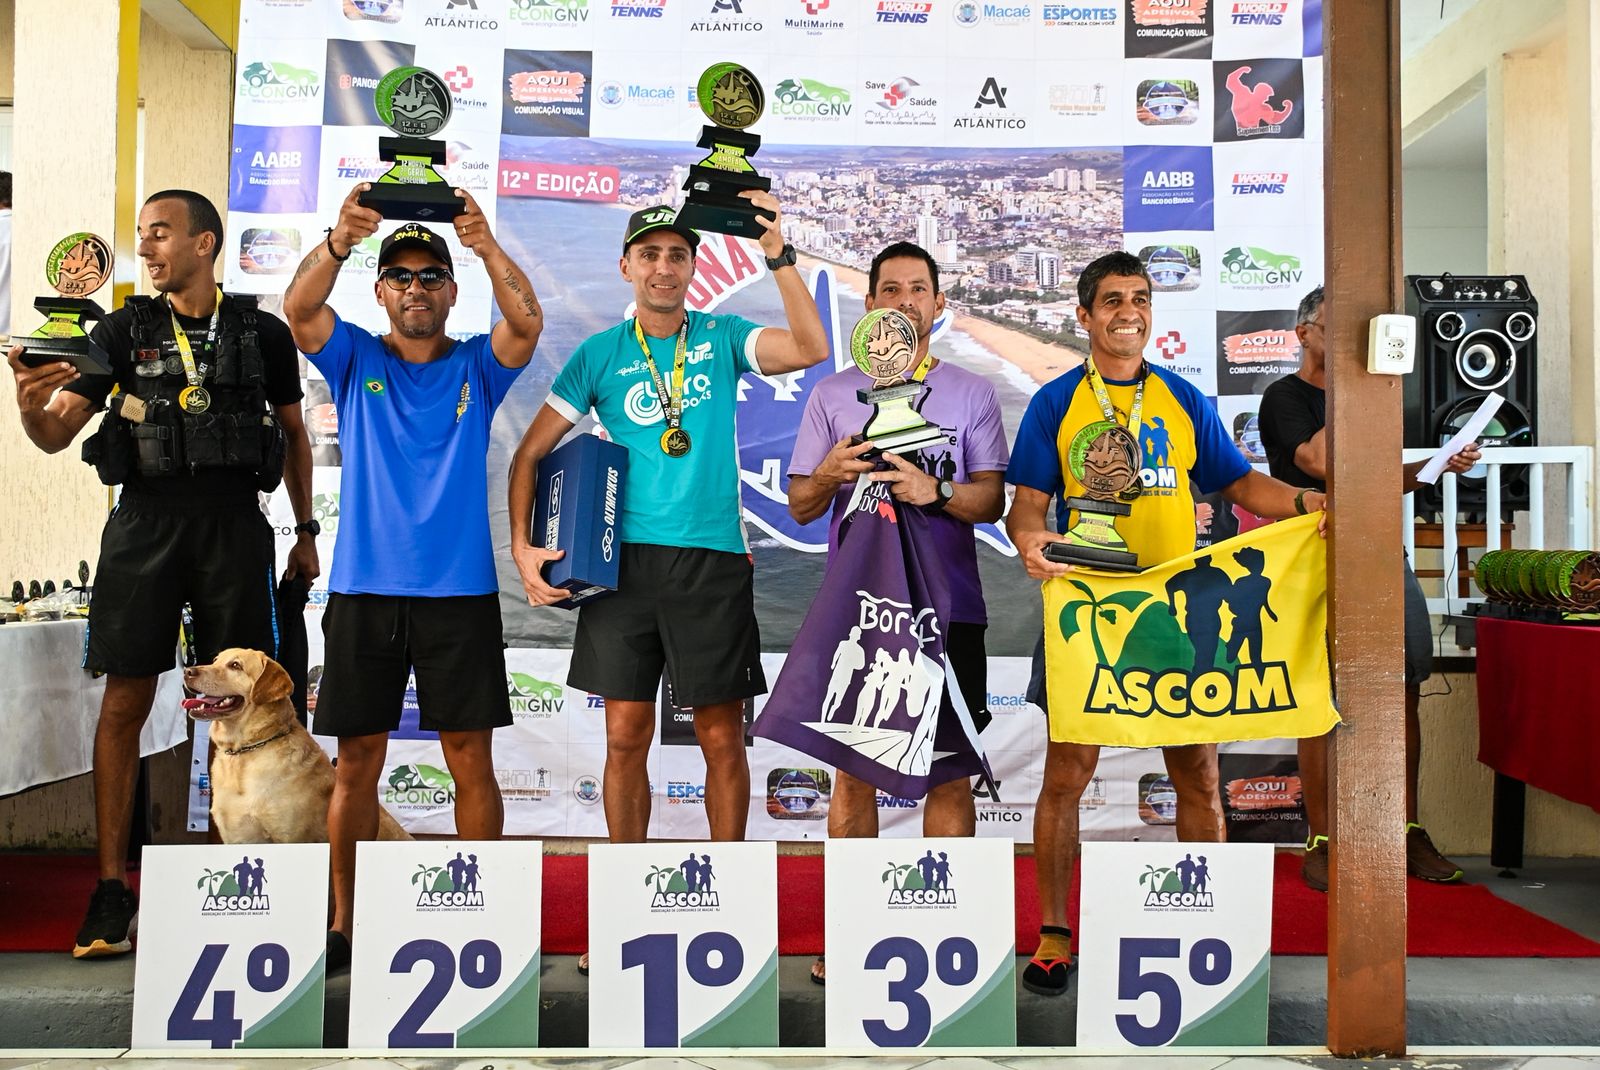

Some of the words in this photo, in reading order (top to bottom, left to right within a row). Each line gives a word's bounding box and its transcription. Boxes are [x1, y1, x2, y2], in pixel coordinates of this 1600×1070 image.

[883, 2, 926, 13] WORLD
[984, 4, 1031, 18] Macaé
[1148, 0, 1191, 9] AQUI
[1238, 3, 1282, 13] WORLD
[509, 9, 588, 22] ECONGNV
[611, 6, 664, 18] TENNIS
[876, 12, 929, 24] TENNIS
[1043, 8, 1117, 21] ESPORTES
[690, 21, 763, 32] ATLÂNTICO
[785, 19, 844, 29] MultiMarine
[1231, 14, 1283, 26] TENNIS
[1136, 28, 1184, 38] COMUNICAÇÃO
[1185, 29, 1208, 37] VISUAL
[527, 75, 569, 87] AQUI
[865, 81, 886, 90] Save
[239, 84, 320, 98] ECONGNV
[628, 84, 676, 99] Macaé
[454, 96, 488, 107] Marine
[909, 97, 938, 107] Saúde
[514, 105, 561, 116] COMUNICAÇÃO
[562, 106, 585, 116] VISUAL
[772, 104, 852, 117] ECONGNV
[954, 117, 1026, 130] ATLÂNTICO
[251, 151, 302, 168] AABB
[462, 161, 489, 170] Saúde
[501, 171, 530, 190] 12ª
[536, 171, 614, 196] EDIÇÃO
[1142, 171, 1195, 188] AABB
[1238, 173, 1284, 184] WORLD
[1231, 184, 1286, 195] TENNIS
[1219, 270, 1303, 285] ECONGNV
[1241, 335, 1285, 347] AQUI
[1229, 365, 1279, 375] COMUNICAÇÃO
[1279, 366, 1300, 375] VISUA
[604, 467, 619, 526] OLYMPIKUS
[1083, 660, 1298, 718] ASCOM
[986, 692, 1027, 706] acaé
[1243, 781, 1287, 792] AQUI
[876, 796, 918, 809] ENNIS
[977, 812, 1022, 823] NTICO
[1231, 812, 1278, 821] COMUNICAÇÃO
[1280, 812, 1302, 821] VISUAL
[202, 895, 270, 911] ASCOM
[416, 891, 484, 907] ASCOM
[651, 891, 720, 907] ASCOM
[888, 889, 957, 905] ASCOM
[1144, 891, 1214, 907] ASCOM
[167, 942, 290, 1049] 4º
[388, 939, 502, 1048] 2º
[621, 931, 744, 1048] 1º
[862, 936, 979, 1047] 3º
[1115, 938, 1232, 1047] 5º
